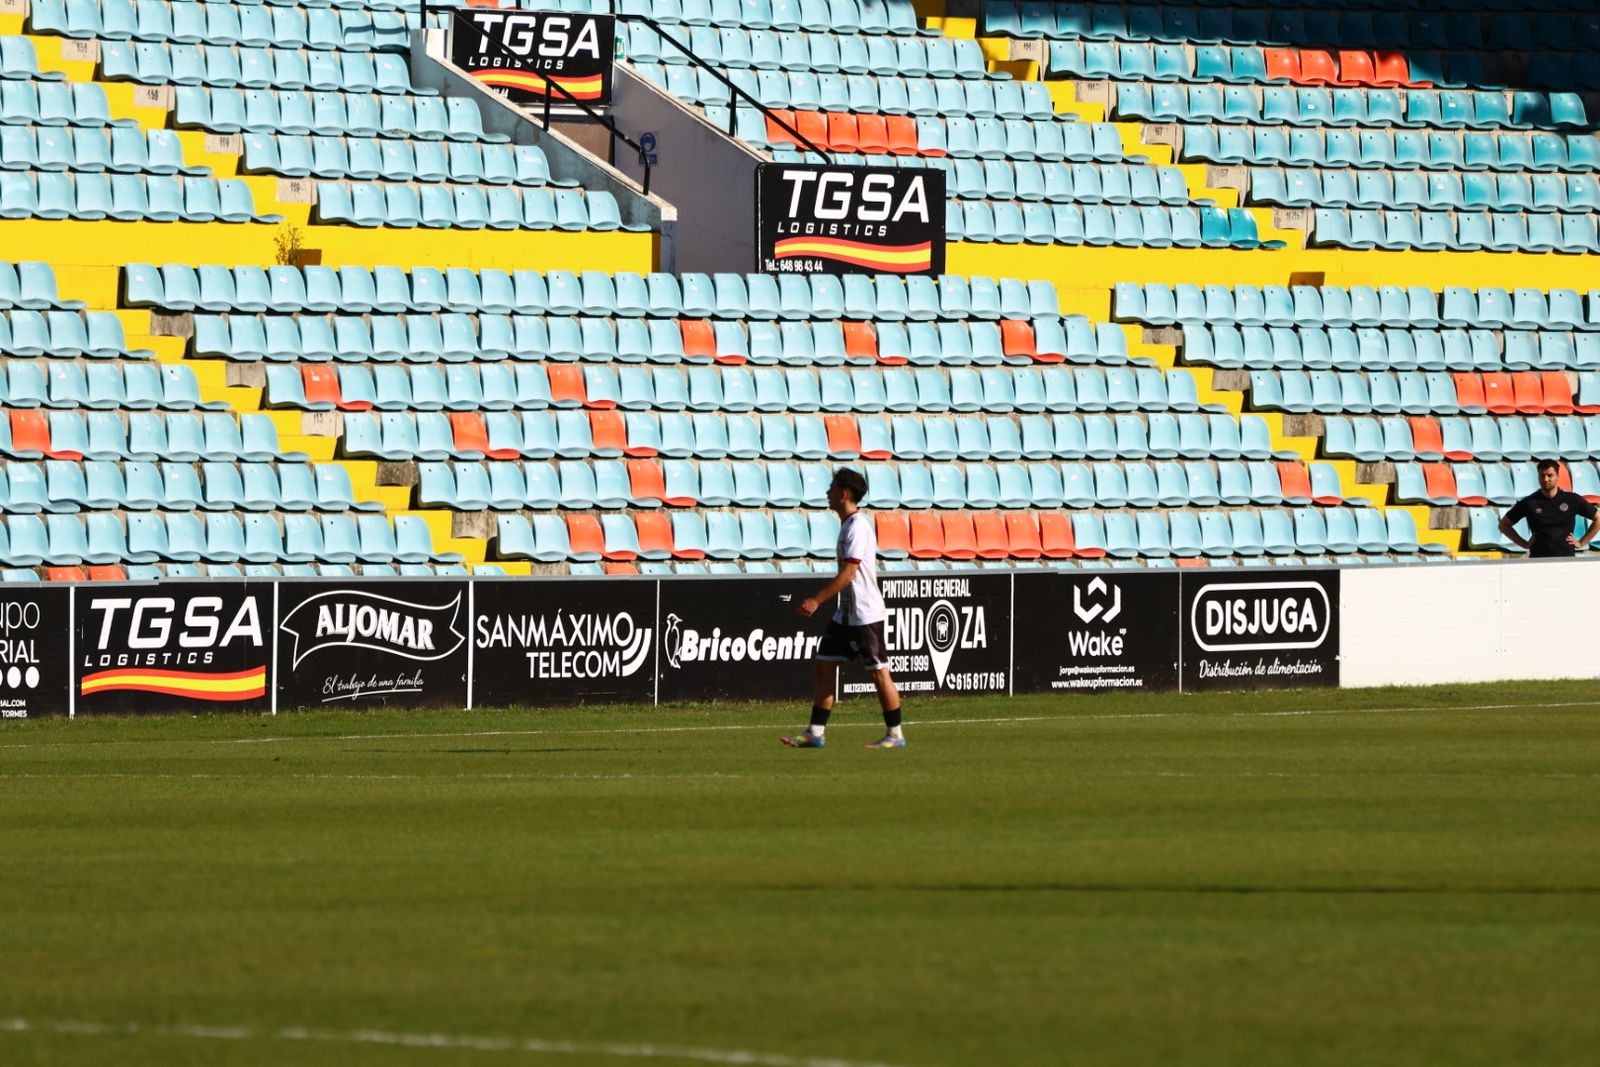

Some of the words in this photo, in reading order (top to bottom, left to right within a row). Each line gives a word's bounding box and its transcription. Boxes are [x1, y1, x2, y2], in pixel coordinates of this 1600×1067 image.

[473, 13, 601, 59] TGSA
[782, 170, 930, 223] TGSA
[777, 221, 888, 237] LOGISTICS
[780, 259, 794, 272] 648
[794, 259, 804, 272] 98
[804, 259, 813, 272] 43
[814, 260, 823, 272] 44
[882, 579, 919, 598] PINTURA
[920, 579, 932, 597] EN
[933, 578, 971, 598] GENERAL
[90, 596, 263, 650] TGSA
[314, 603, 436, 650] ALJOMAR
[476, 608, 634, 649] SANMÁXIMO
[1206, 597, 1318, 635] DISJUGA
[680, 627, 822, 662] BricoCentr
[1068, 630, 1124, 657] Wake
[84, 651, 214, 667] LOGISTICS
[526, 651, 621, 679] TELECOM
[910, 654, 929, 672] 1999
[1199, 659, 1253, 679] Distribución
[1254, 657, 1266, 675] de
[1267, 657, 1323, 675] alimentación
[322, 674, 339, 694] El
[337, 673, 366, 700] trabajo
[366, 674, 378, 688] de
[378, 679, 394, 687] una
[392, 669, 424, 691] familia
[956, 672, 972, 690] 615
[973, 672, 989, 690] 817
[990, 672, 1005, 690] 616
[1051, 676, 1143, 690] www.wakeupformacion.es
